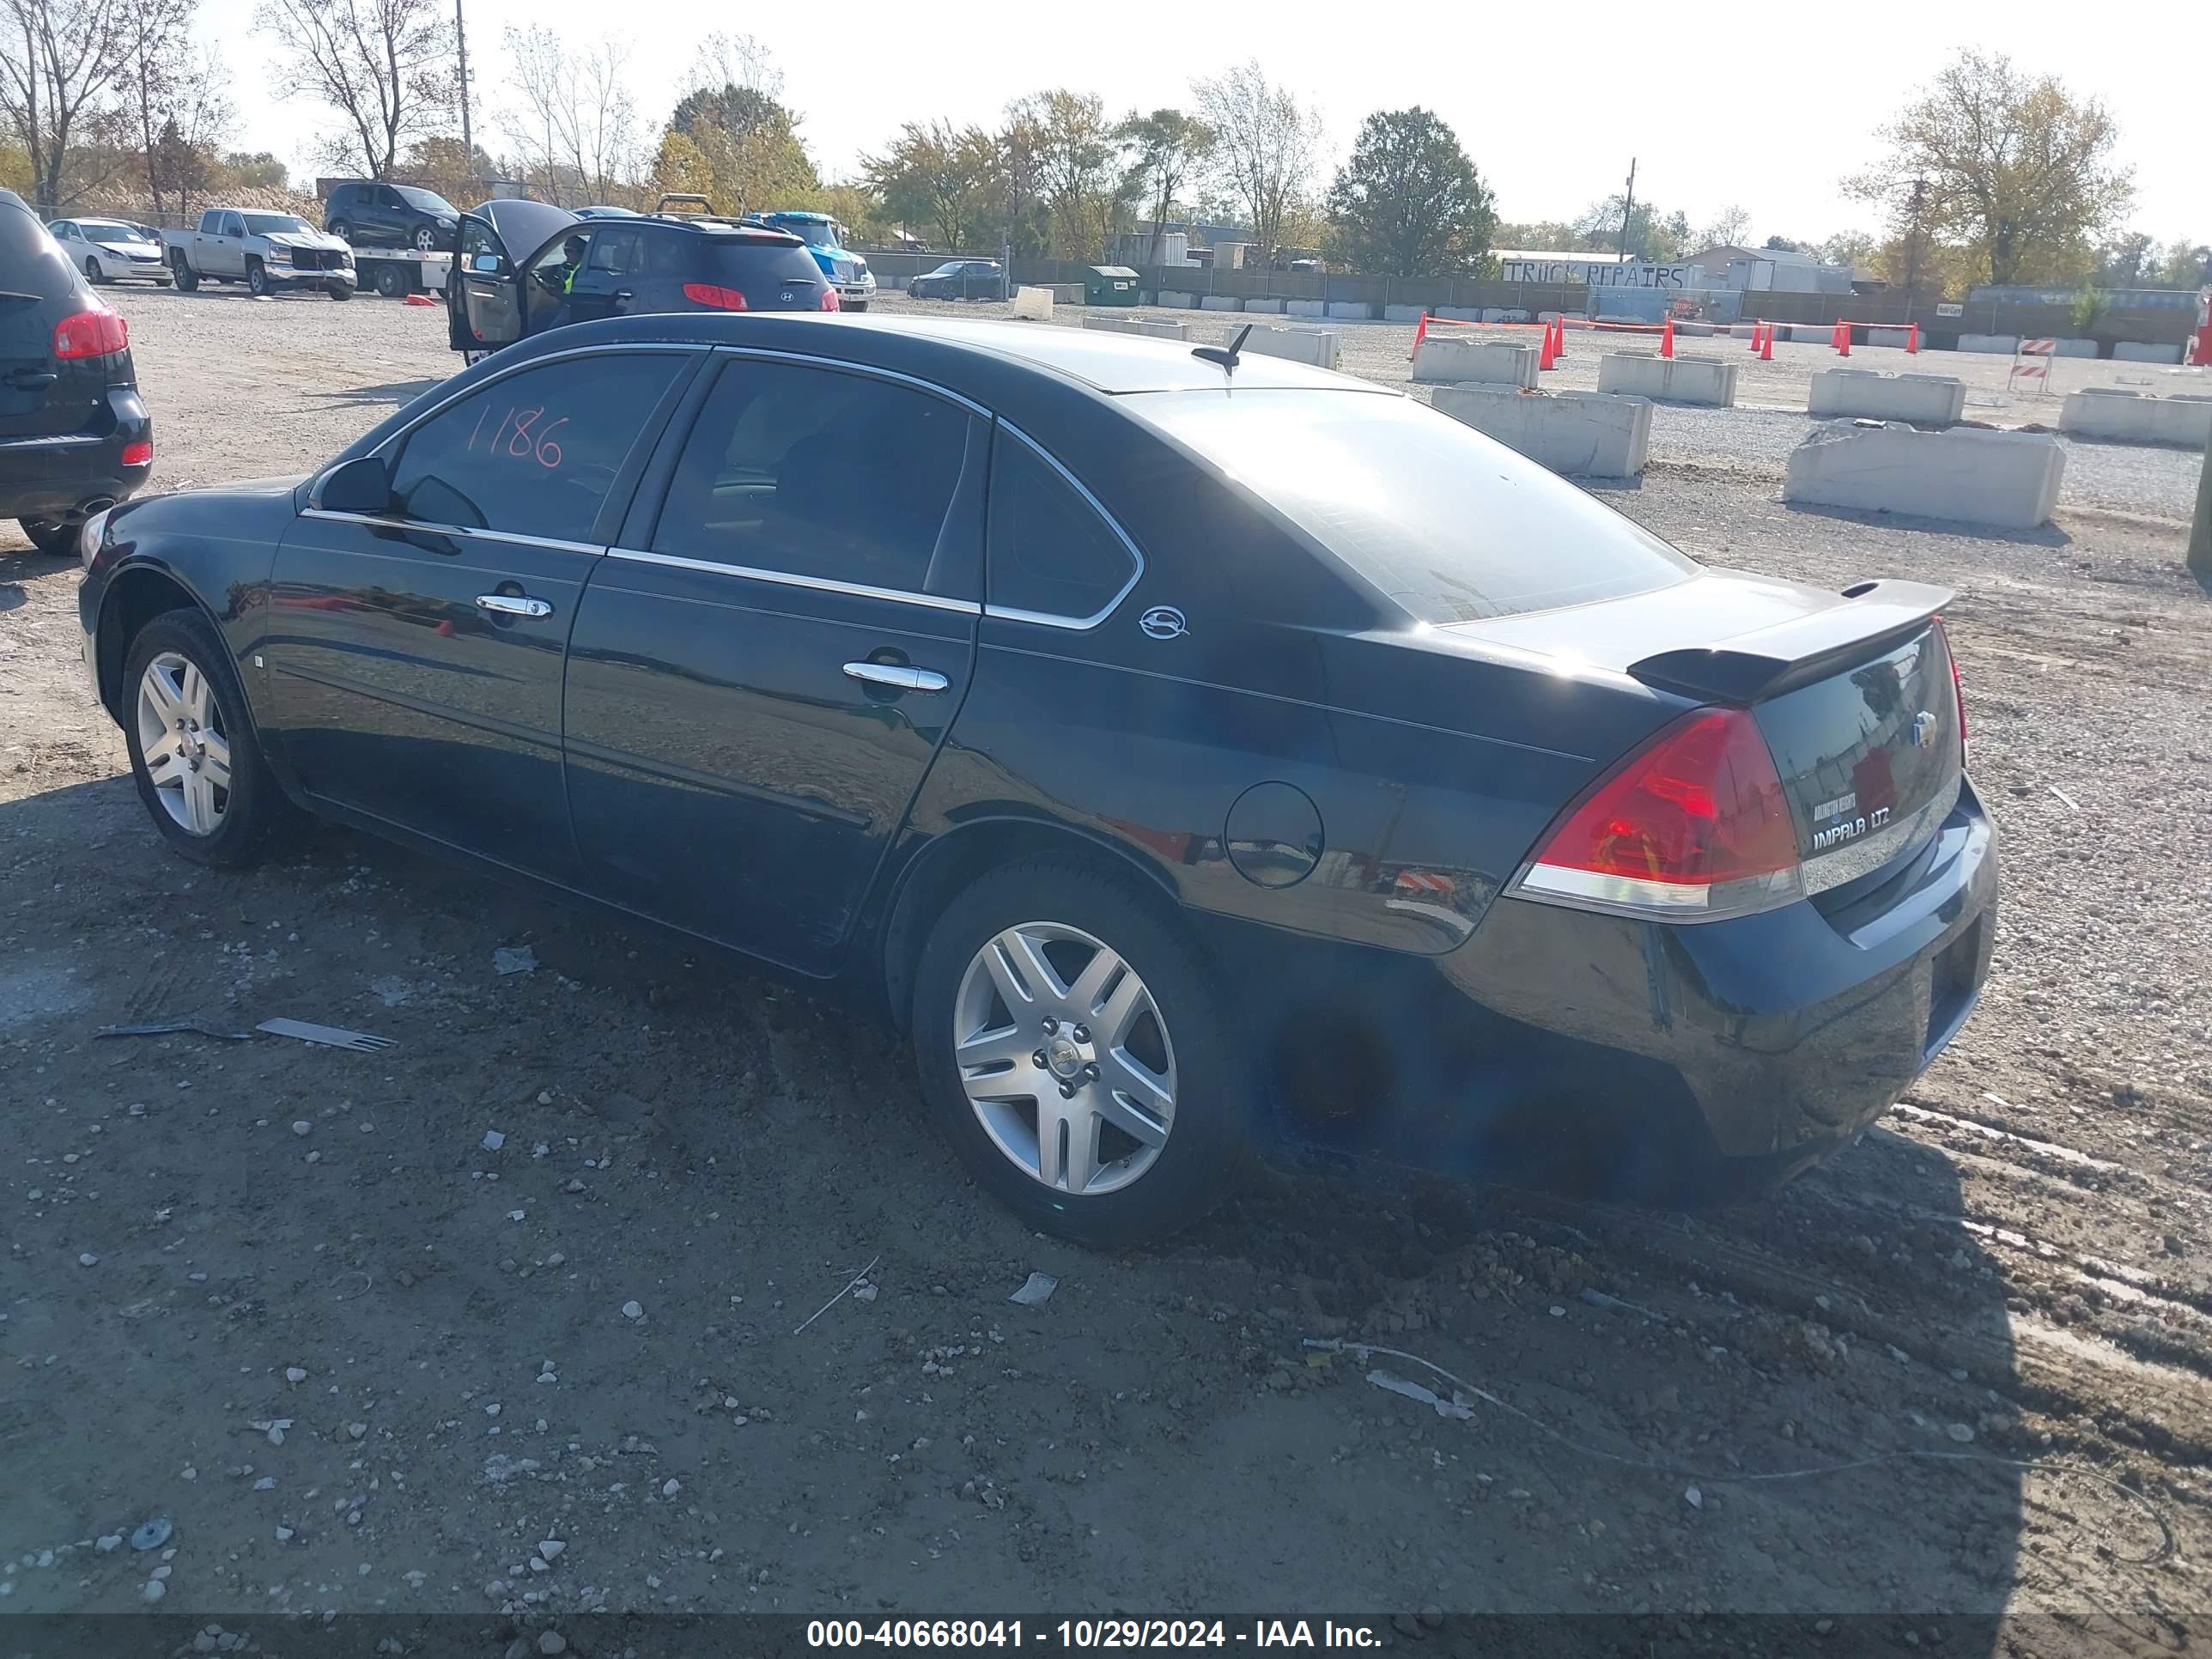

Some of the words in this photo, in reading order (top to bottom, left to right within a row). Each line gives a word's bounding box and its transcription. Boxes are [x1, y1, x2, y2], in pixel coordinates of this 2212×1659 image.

[1505, 262, 1578, 283] TRUCK
[1587, 265, 1685, 289] REPAIRS
[468, 404, 570, 468] 1186
[1814, 817, 1866, 850] IMPALA
[1870, 806, 1890, 830] LTZ
